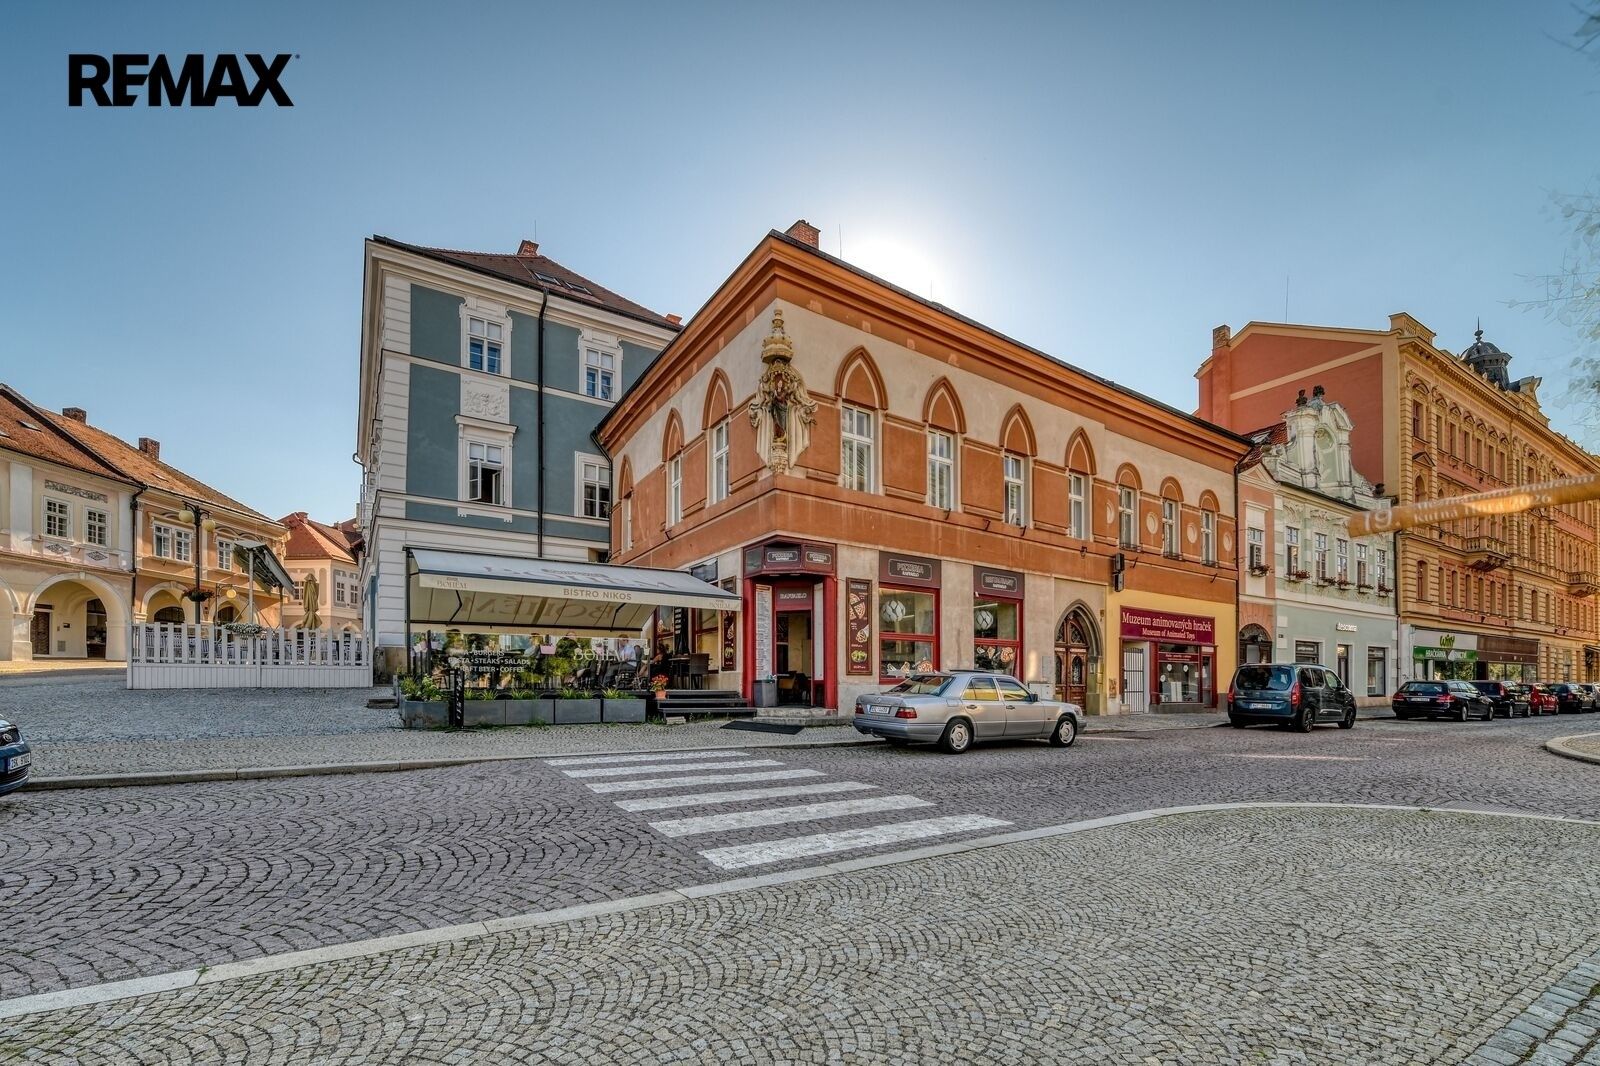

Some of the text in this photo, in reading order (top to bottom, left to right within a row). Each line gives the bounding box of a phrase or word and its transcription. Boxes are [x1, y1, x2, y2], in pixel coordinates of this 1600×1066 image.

[563, 588, 632, 601] BISTRO NIKOS
[1122, 611, 1212, 632] Muzeum animovaných hraček
[1142, 627, 1161, 636] Museum
[1166, 630, 1186, 638] Animated
[1186, 631, 1195, 640] Toys
